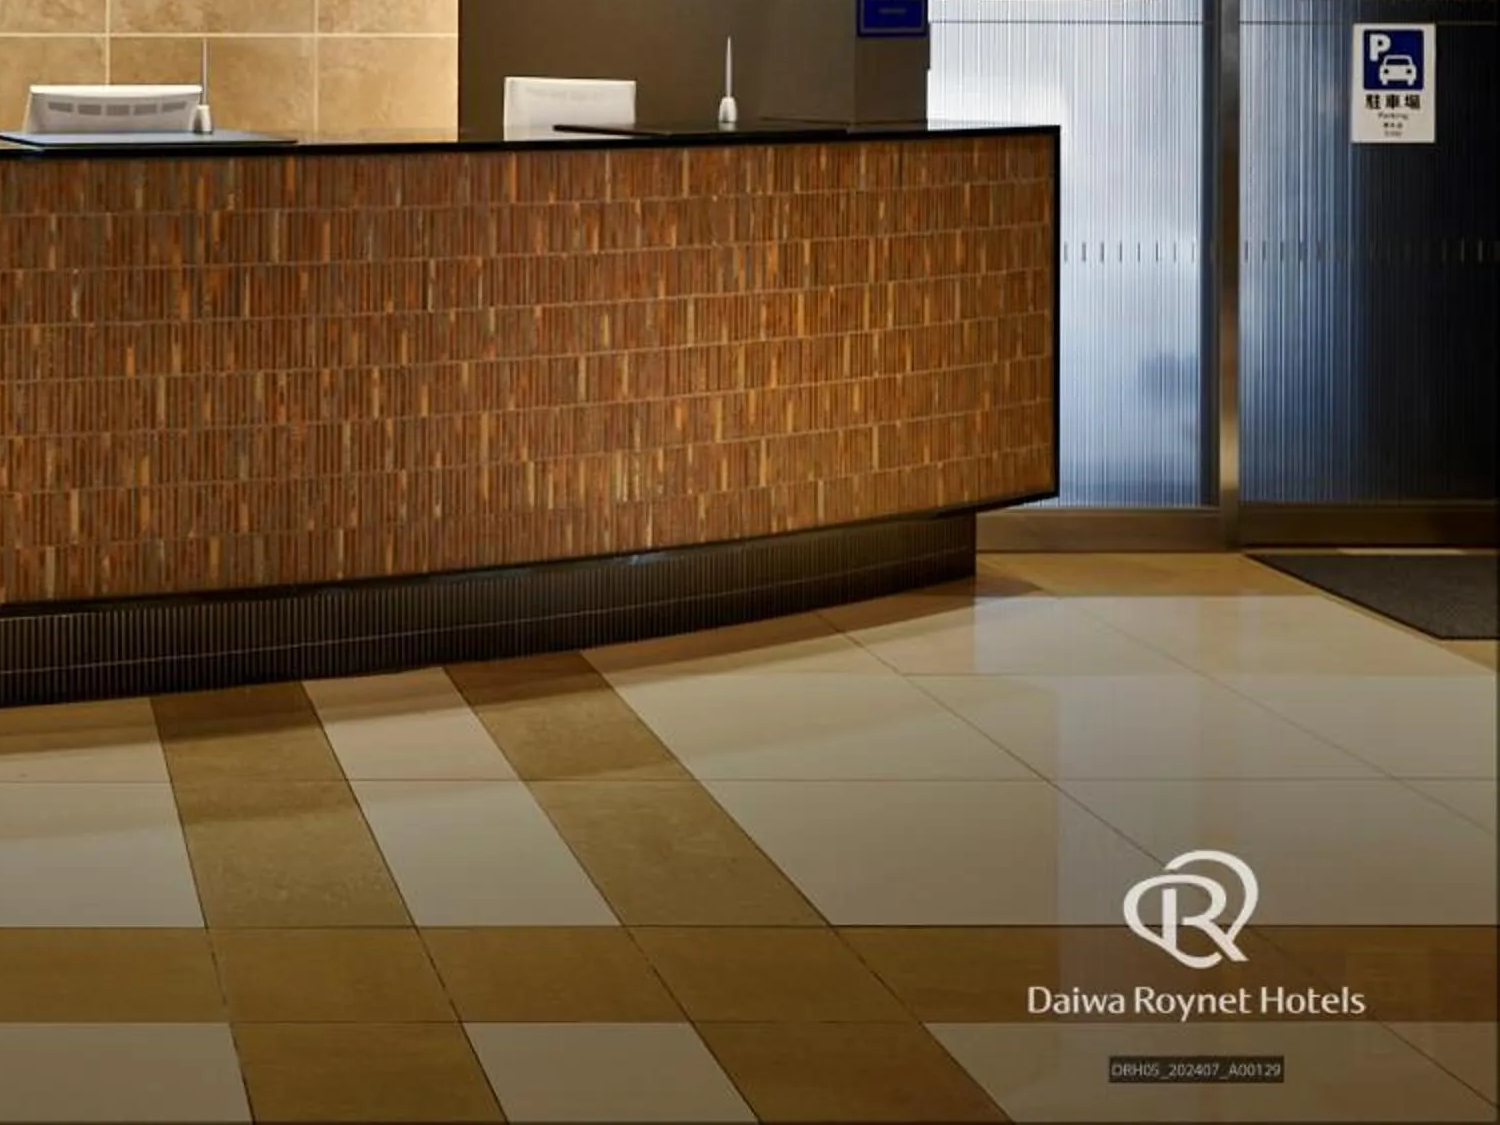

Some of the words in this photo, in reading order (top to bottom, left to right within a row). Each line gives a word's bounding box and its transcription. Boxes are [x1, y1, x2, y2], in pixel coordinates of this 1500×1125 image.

[1369, 33, 1392, 62] P
[1365, 94, 1421, 110] 駐車場
